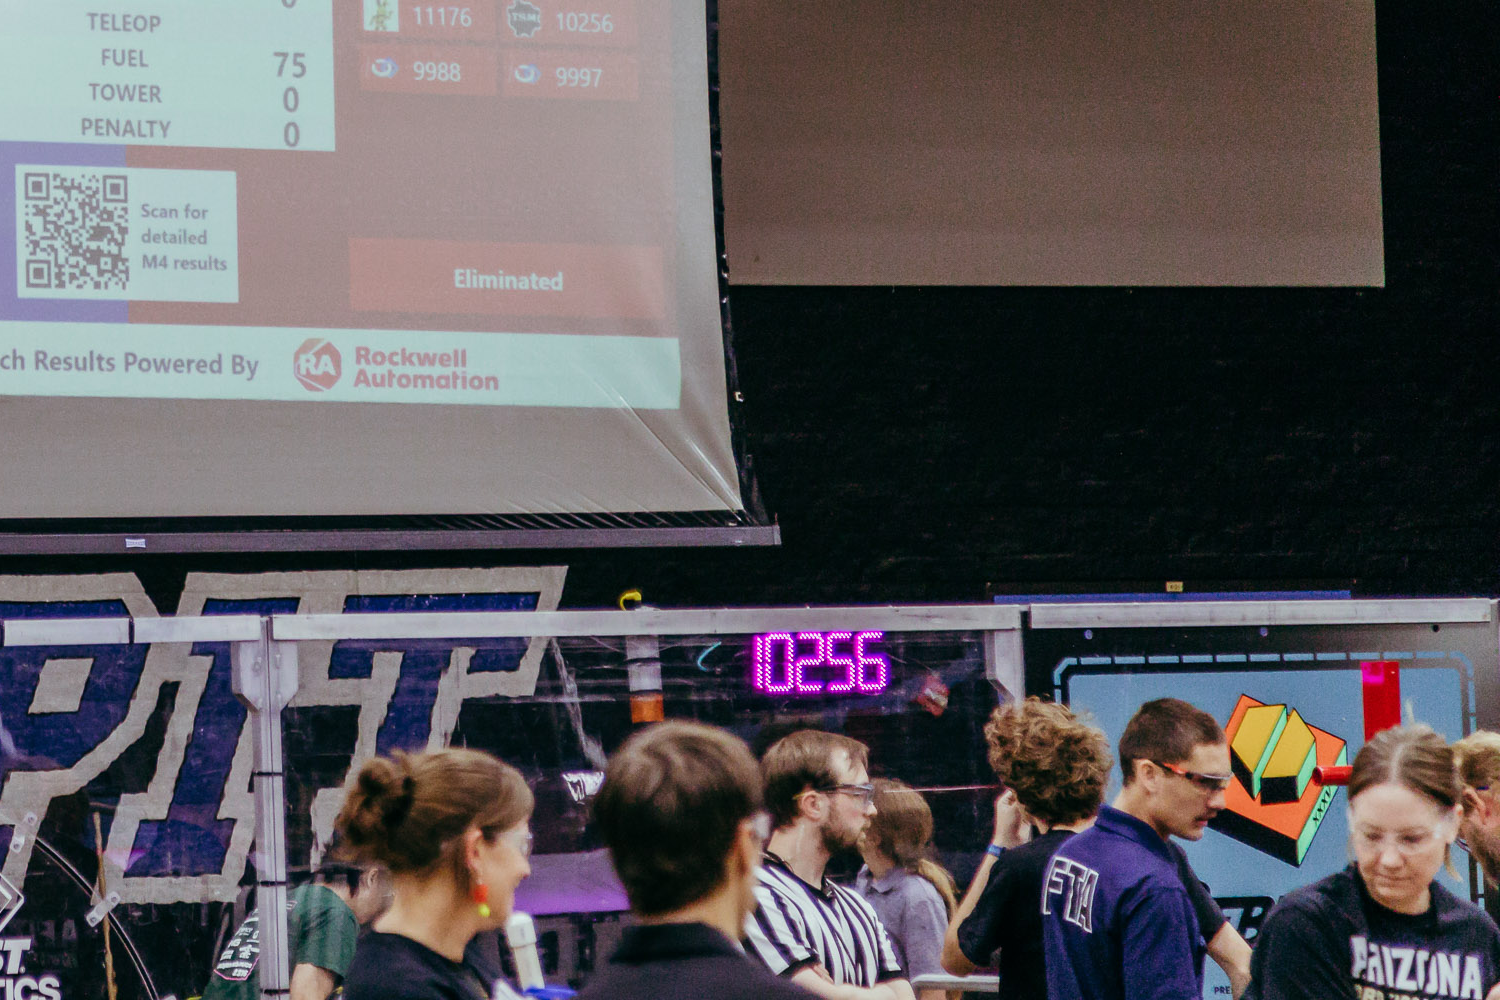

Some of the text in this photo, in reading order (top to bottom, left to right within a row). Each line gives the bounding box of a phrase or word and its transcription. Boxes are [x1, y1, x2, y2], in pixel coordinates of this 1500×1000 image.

[86, 13, 161, 32] TELEOP
[412, 6, 472, 27] 11176
[556, 12, 613, 34] 10256
[101, 49, 149, 68] FUEL
[273, 51, 306, 78] 75
[412, 62, 461, 82] 9988
[555, 67, 602, 88] 9997
[89, 83, 162, 103] TOWER
[283, 87, 299, 112] 0
[81, 118, 171, 138] PENALTY
[284, 121, 299, 147] 0
[141, 204, 208, 220] Scan for
[141, 229, 208, 246] detailed
[142, 255, 227, 271] M4 results
[454, 269, 564, 291] Eliminated
[34, 351, 116, 373] Results
[124, 353, 222, 375] Powered
[230, 355, 258, 380] By
[355, 346, 467, 368] Rockwell
[353, 369, 499, 391] Automation
[756, 631, 886, 692] 10256
[1043, 856, 1099, 933] FTA
